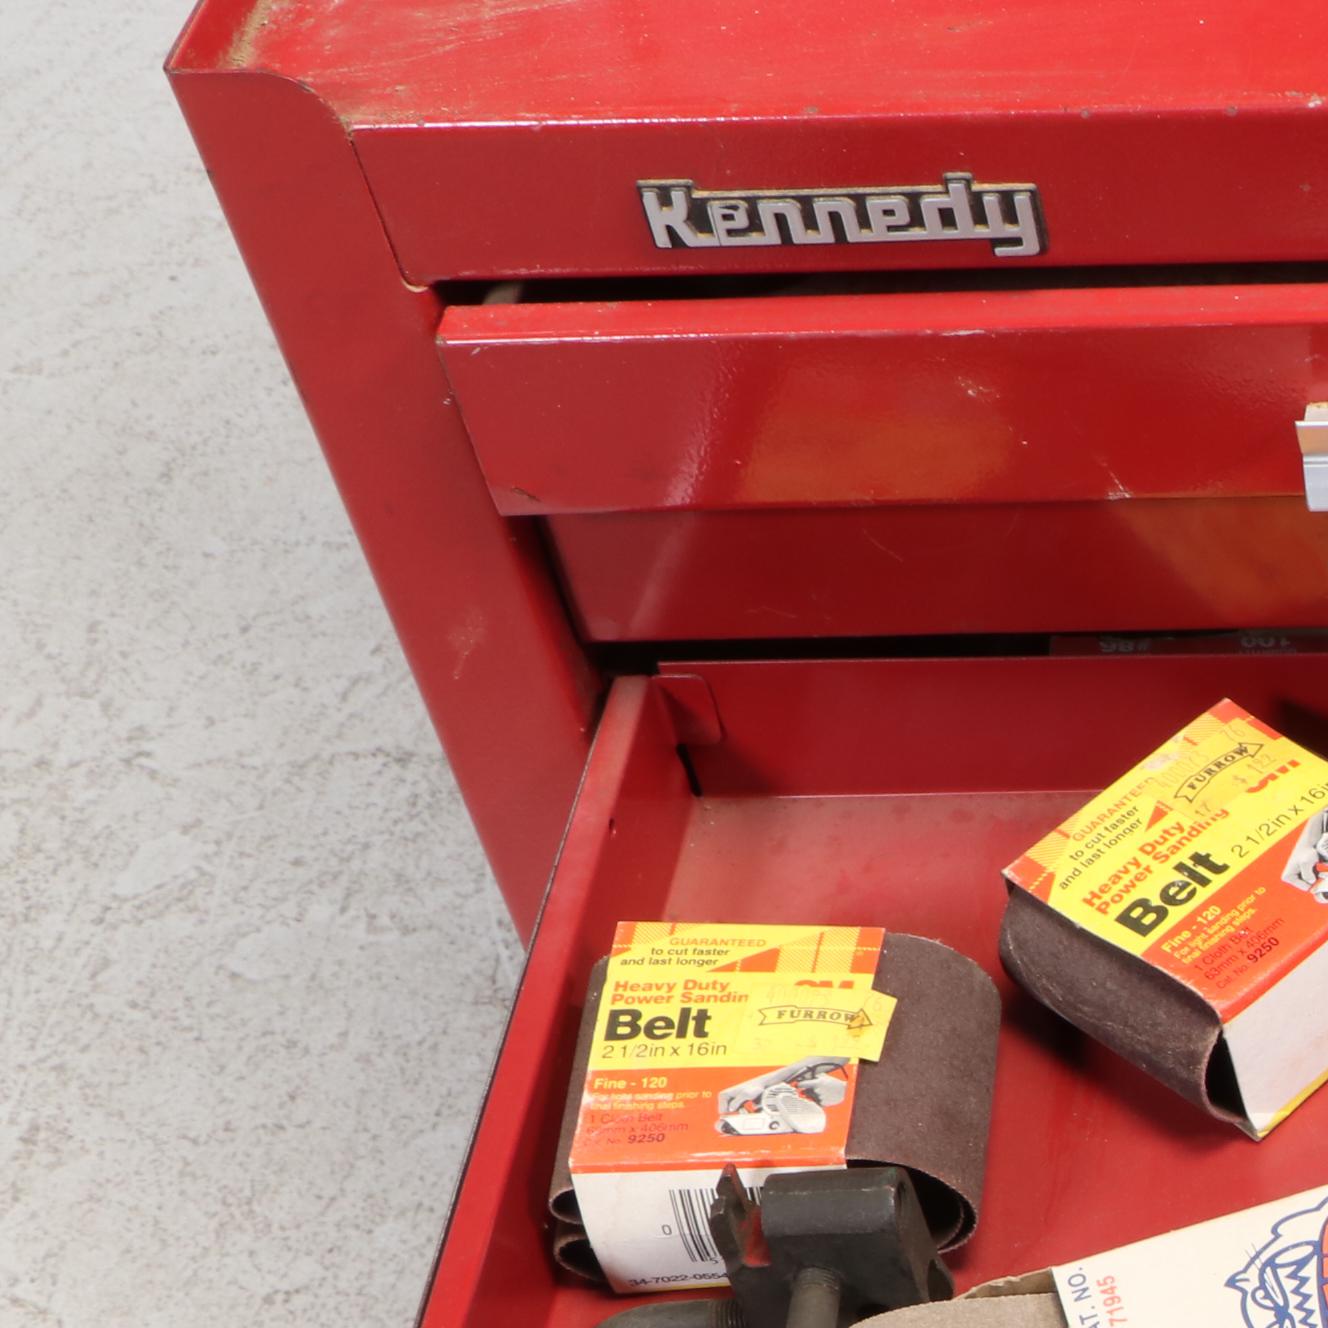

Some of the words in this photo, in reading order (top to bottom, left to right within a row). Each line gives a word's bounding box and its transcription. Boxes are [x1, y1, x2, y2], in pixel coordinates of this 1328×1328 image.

[641, 181, 1040, 257] Kennedy
[1186, 744, 1250, 791] FURROW
[1069, 849, 1084, 861] to
[1085, 832, 1105, 850] cut
[1104, 805, 1139, 835] faster
[1230, 844, 1250, 859] 2
[1288, 804, 1304, 816] x
[1058, 866, 1083, 890] and
[1081, 847, 1106, 869] last
[1104, 817, 1144, 850] longer
[1082, 856, 1143, 907] Heavy
[1138, 820, 1185, 857] Duty
[1095, 864, 1154, 916] Power
[1114, 851, 1231, 938] Belt
[670, 937, 767, 947] GUARANTEED
[1161, 930, 1192, 953] Fine
[1196, 905, 1221, 924] 120
[620, 958, 644, 966] and
[649, 957, 672, 966] last
[676, 957, 718, 967] longer
[651, 948, 663, 956] to
[668, 947, 688, 956] cut
[692, 947, 729, 956] faster
[1202, 943, 1232, 966] Cloth
[1247, 936, 1280, 963] 9250
[611, 993, 674, 1005] Power
[680, 992, 749, 1003] Sandin
[613, 981, 677, 993] Heavy
[683, 979, 730, 992] Duty
[604, 1007, 712, 1041] Belt
[777, 1009, 860, 1023] FURROW
[602, 1045, 614, 1058] 2
[670, 1046, 681, 1056] x
[688, 1042, 728, 1056] 16in
[593, 1077, 627, 1089] Fine
[642, 1077, 668, 1089] 120
[628, 1133, 665, 1144] 9250
[1067, 1266, 1092, 1303] NO.
[1096, 1275, 1128, 1327] 71945
